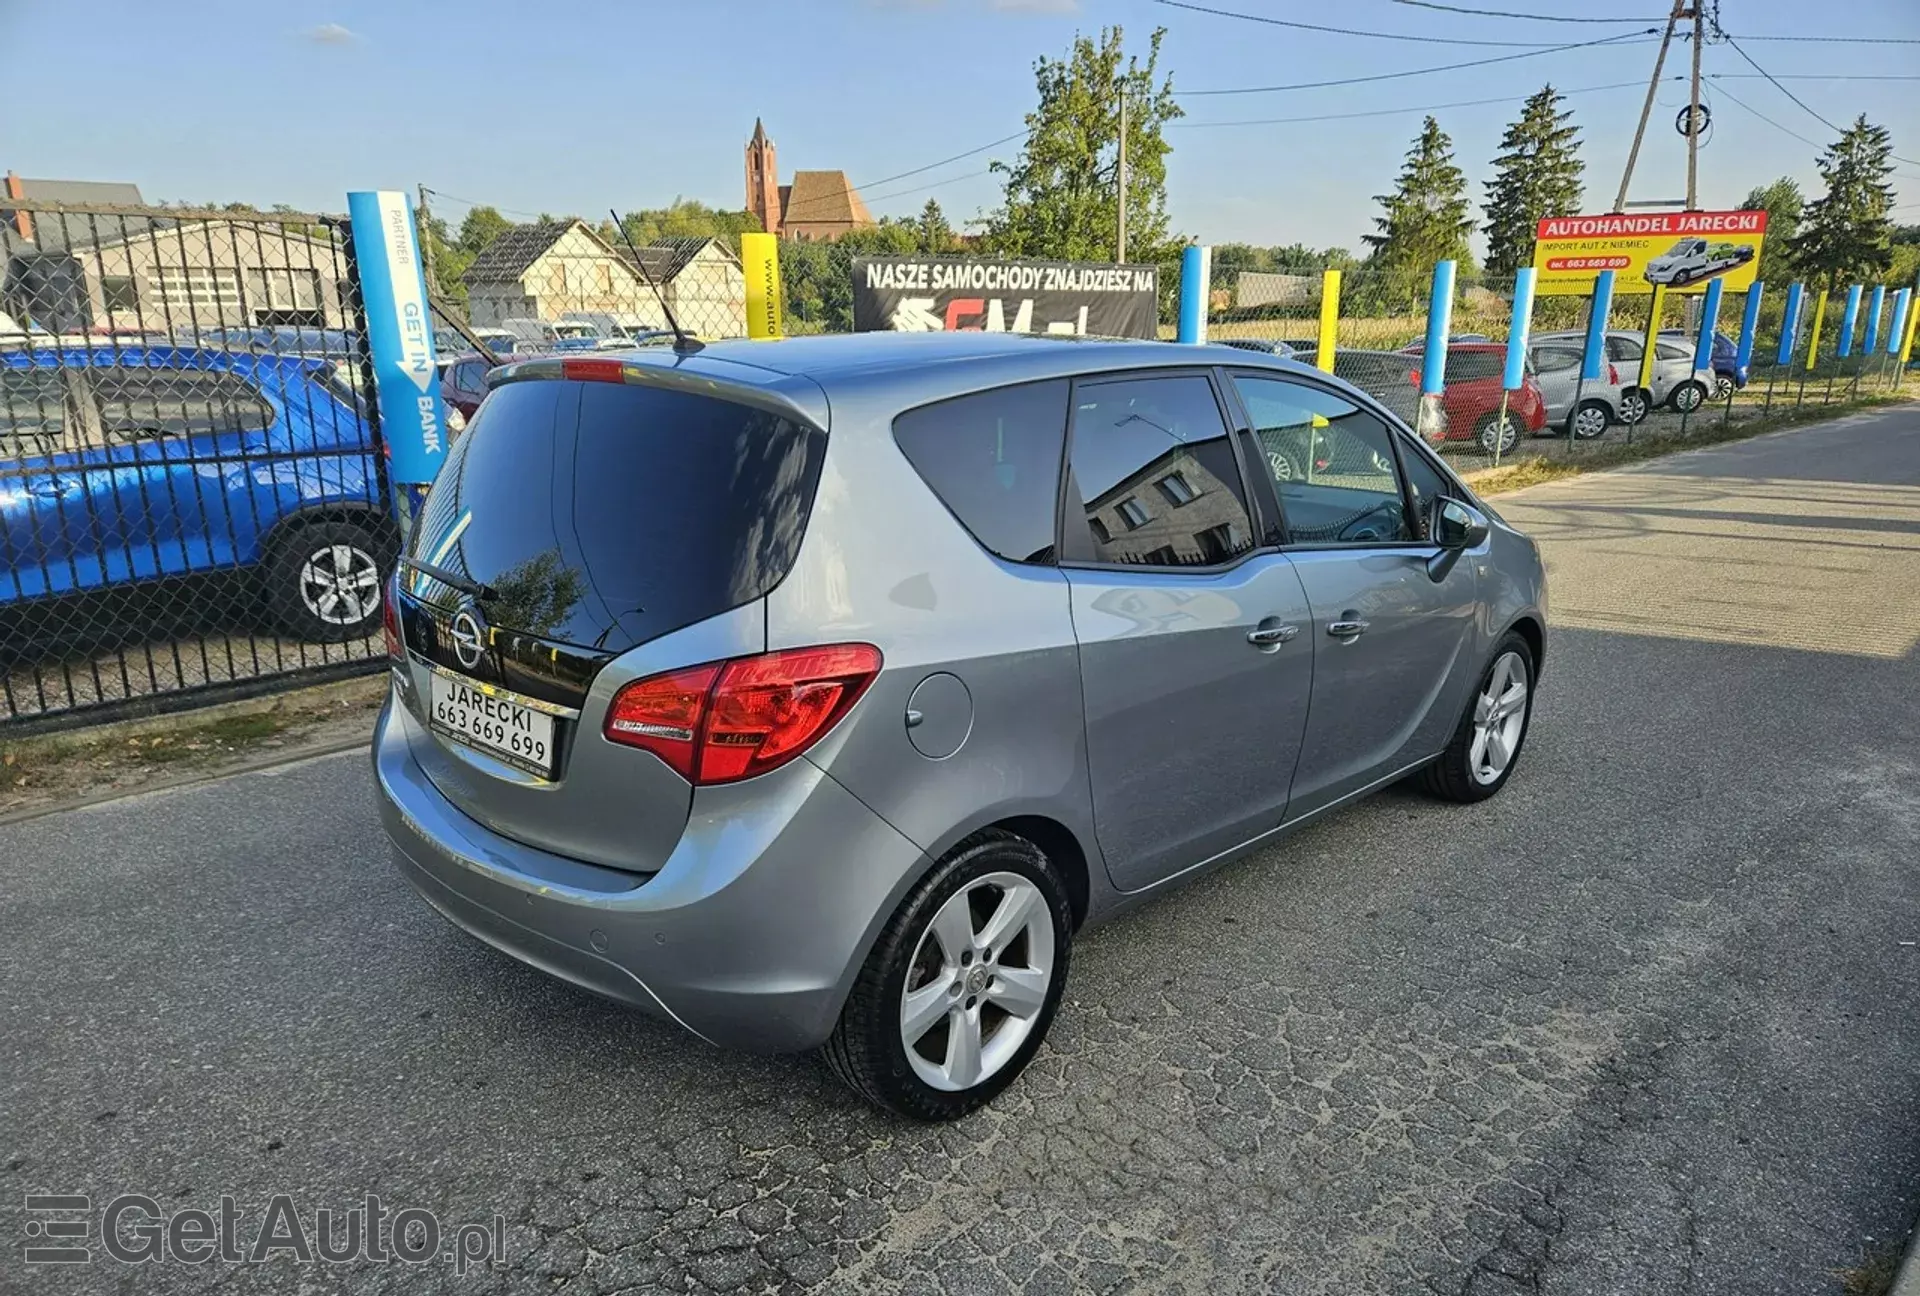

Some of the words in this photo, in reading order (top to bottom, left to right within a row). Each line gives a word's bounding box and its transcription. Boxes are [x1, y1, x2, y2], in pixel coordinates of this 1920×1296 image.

[391, 208, 410, 265] PARTNER
[1545, 217, 1671, 236] AUTOHANDEL
[1676, 215, 1758, 232] JARECKI
[1543, 241, 1578, 251] IMPORT
[1580, 240, 1600, 250] AUT
[1601, 240, 1608, 249] Z
[1609, 239, 1650, 249] NIEMIEC
[1550, 261, 1564, 269] tel.
[1566, 259, 1586, 269] 663
[1587, 258, 1606, 268] 669
[1608, 257, 1628, 267] 699
[866, 263, 929, 290] NASZE
[931, 264, 1043, 291] SAMOCHODY
[1043, 267, 1133, 292] ZNAJDZIESZ
[1133, 270, 1154, 293] NA
[404, 302, 424, 347] GET
[410, 351, 428, 373] IN
[417, 395, 441, 455] BANK
[446, 683, 532, 732] JARECKI
[437, 701, 467, 729] 663
[472, 716, 505, 744] 669
[510, 731, 546, 761] 699
